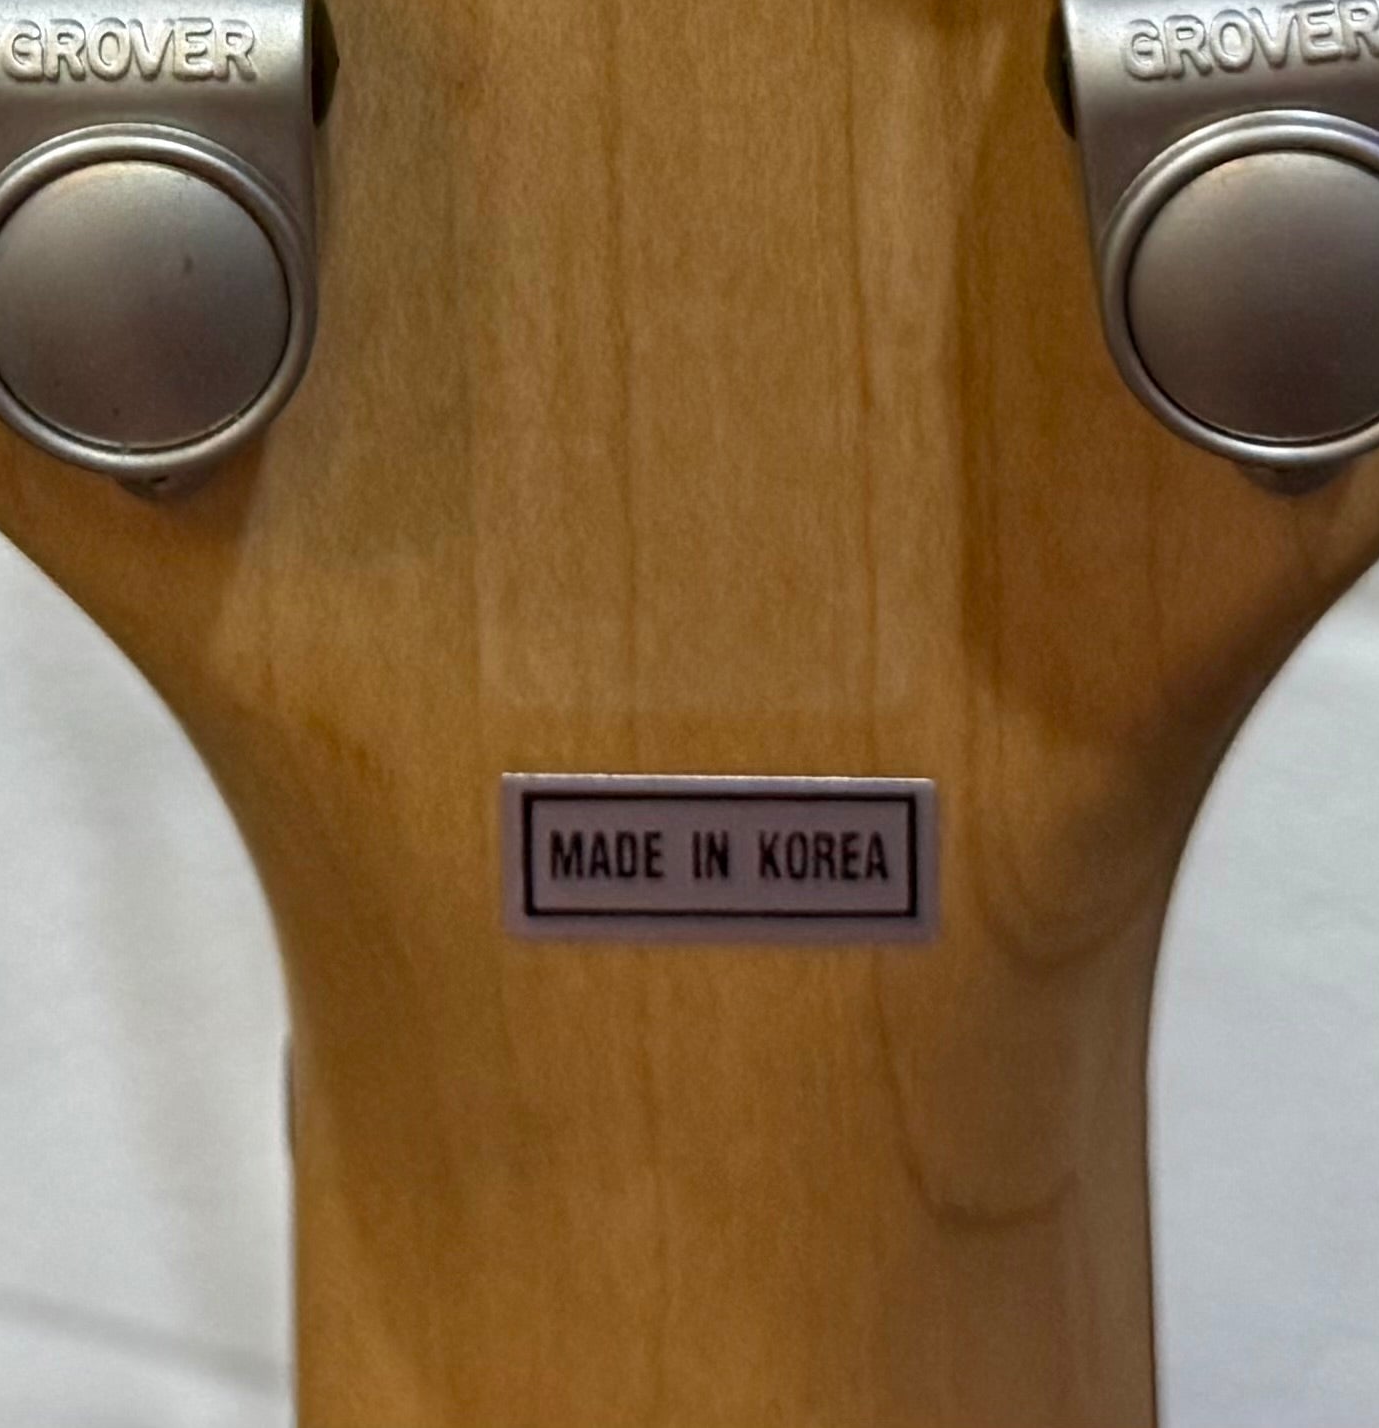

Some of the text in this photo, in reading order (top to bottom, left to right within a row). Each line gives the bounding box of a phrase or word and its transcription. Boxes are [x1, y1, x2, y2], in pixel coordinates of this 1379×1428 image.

[4, 17, 257, 81] GROVER
[550, 830, 889, 881] MADE IN KOREA
